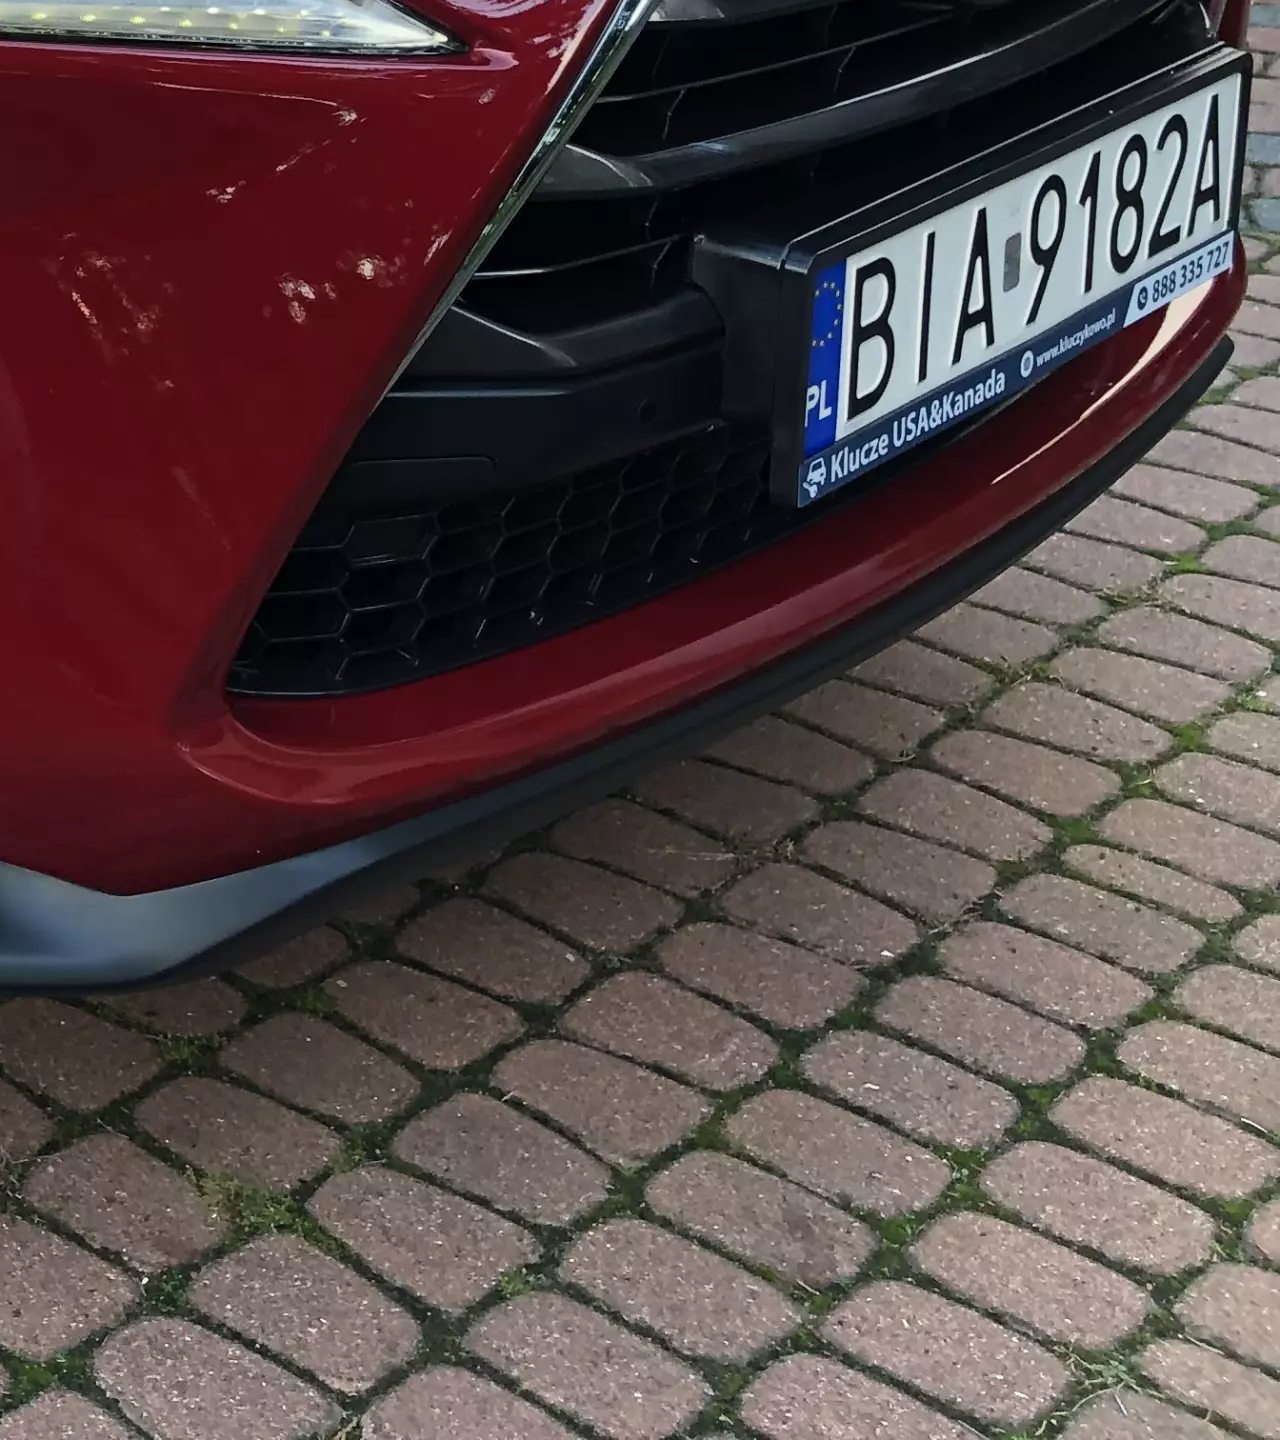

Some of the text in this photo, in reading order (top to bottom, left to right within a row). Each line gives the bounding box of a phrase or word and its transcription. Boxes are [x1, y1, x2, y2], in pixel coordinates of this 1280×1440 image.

[846, 93, 1221, 420] BIA 9182A
[1152, 240, 1230, 303] 888 335 727
[1036, 308, 1116, 367] www.kluczykowo.pl
[805, 380, 832, 427] PL
[830, 369, 1006, 482] Klucze USA&Kanada
